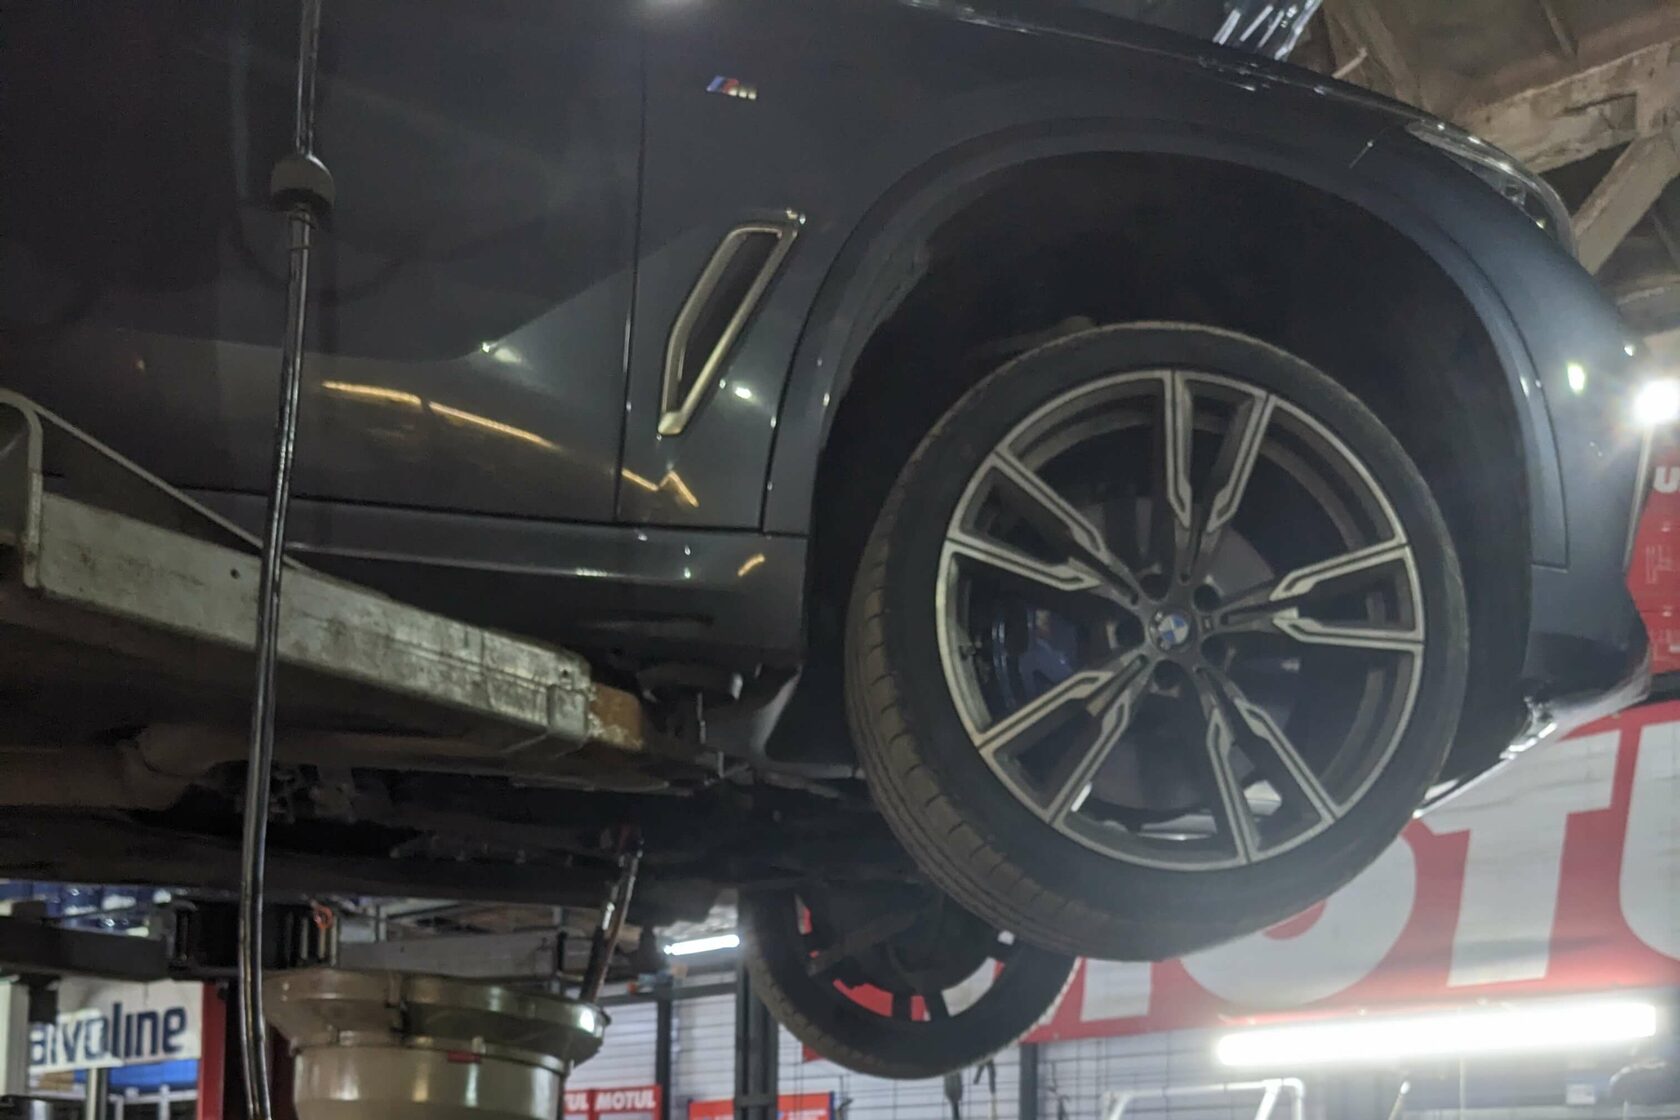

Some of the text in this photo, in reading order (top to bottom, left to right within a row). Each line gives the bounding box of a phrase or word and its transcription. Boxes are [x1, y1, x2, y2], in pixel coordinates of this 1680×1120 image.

[29, 1002, 187, 1066] alvoline
[563, 1093, 589, 1112] UL
[594, 1090, 656, 1112] MOTUL
